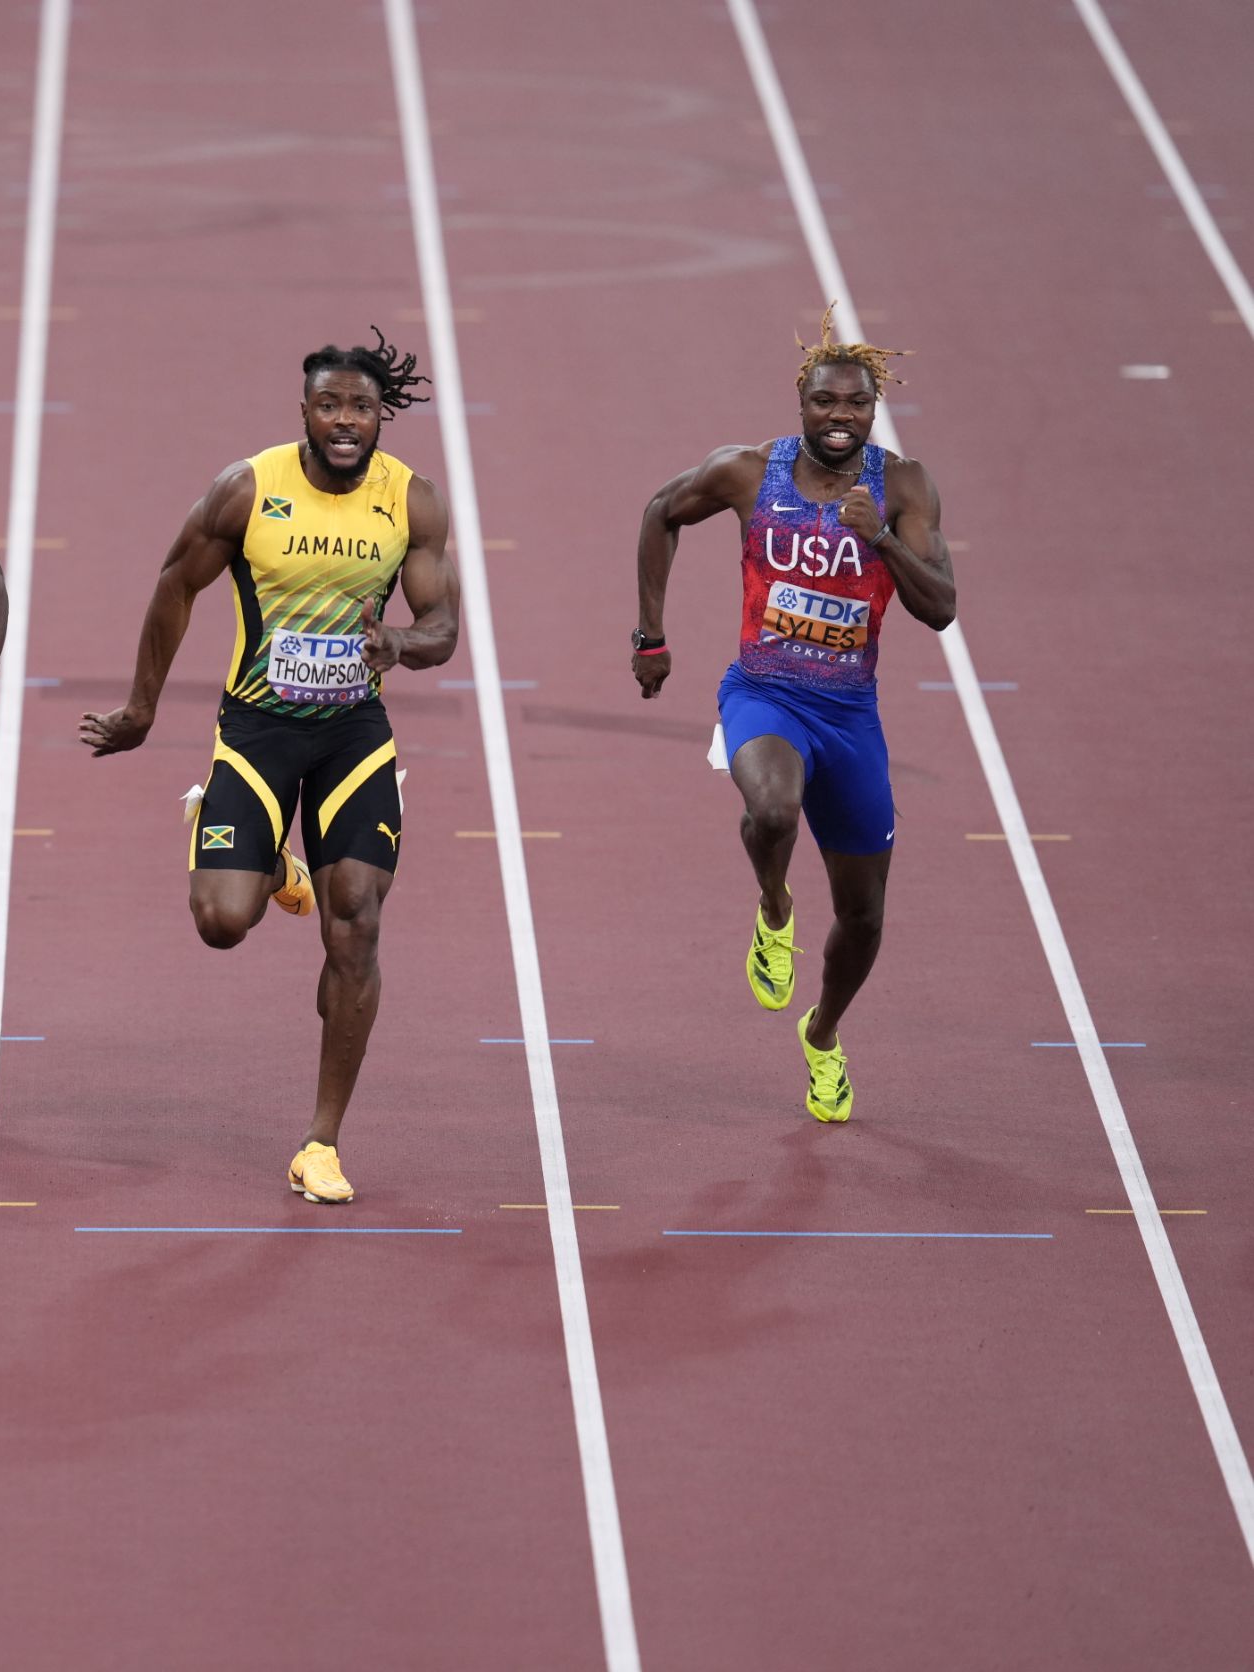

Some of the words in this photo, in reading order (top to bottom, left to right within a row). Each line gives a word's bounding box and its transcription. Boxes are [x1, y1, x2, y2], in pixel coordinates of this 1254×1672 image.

[282, 536, 381, 562] JAMAICA
[766, 528, 863, 577] USA
[799, 591, 868, 625] TDK
[776, 613, 856, 649] LYLES
[303, 637, 368, 659] TDK
[274, 658, 367, 686] THOMPSON
